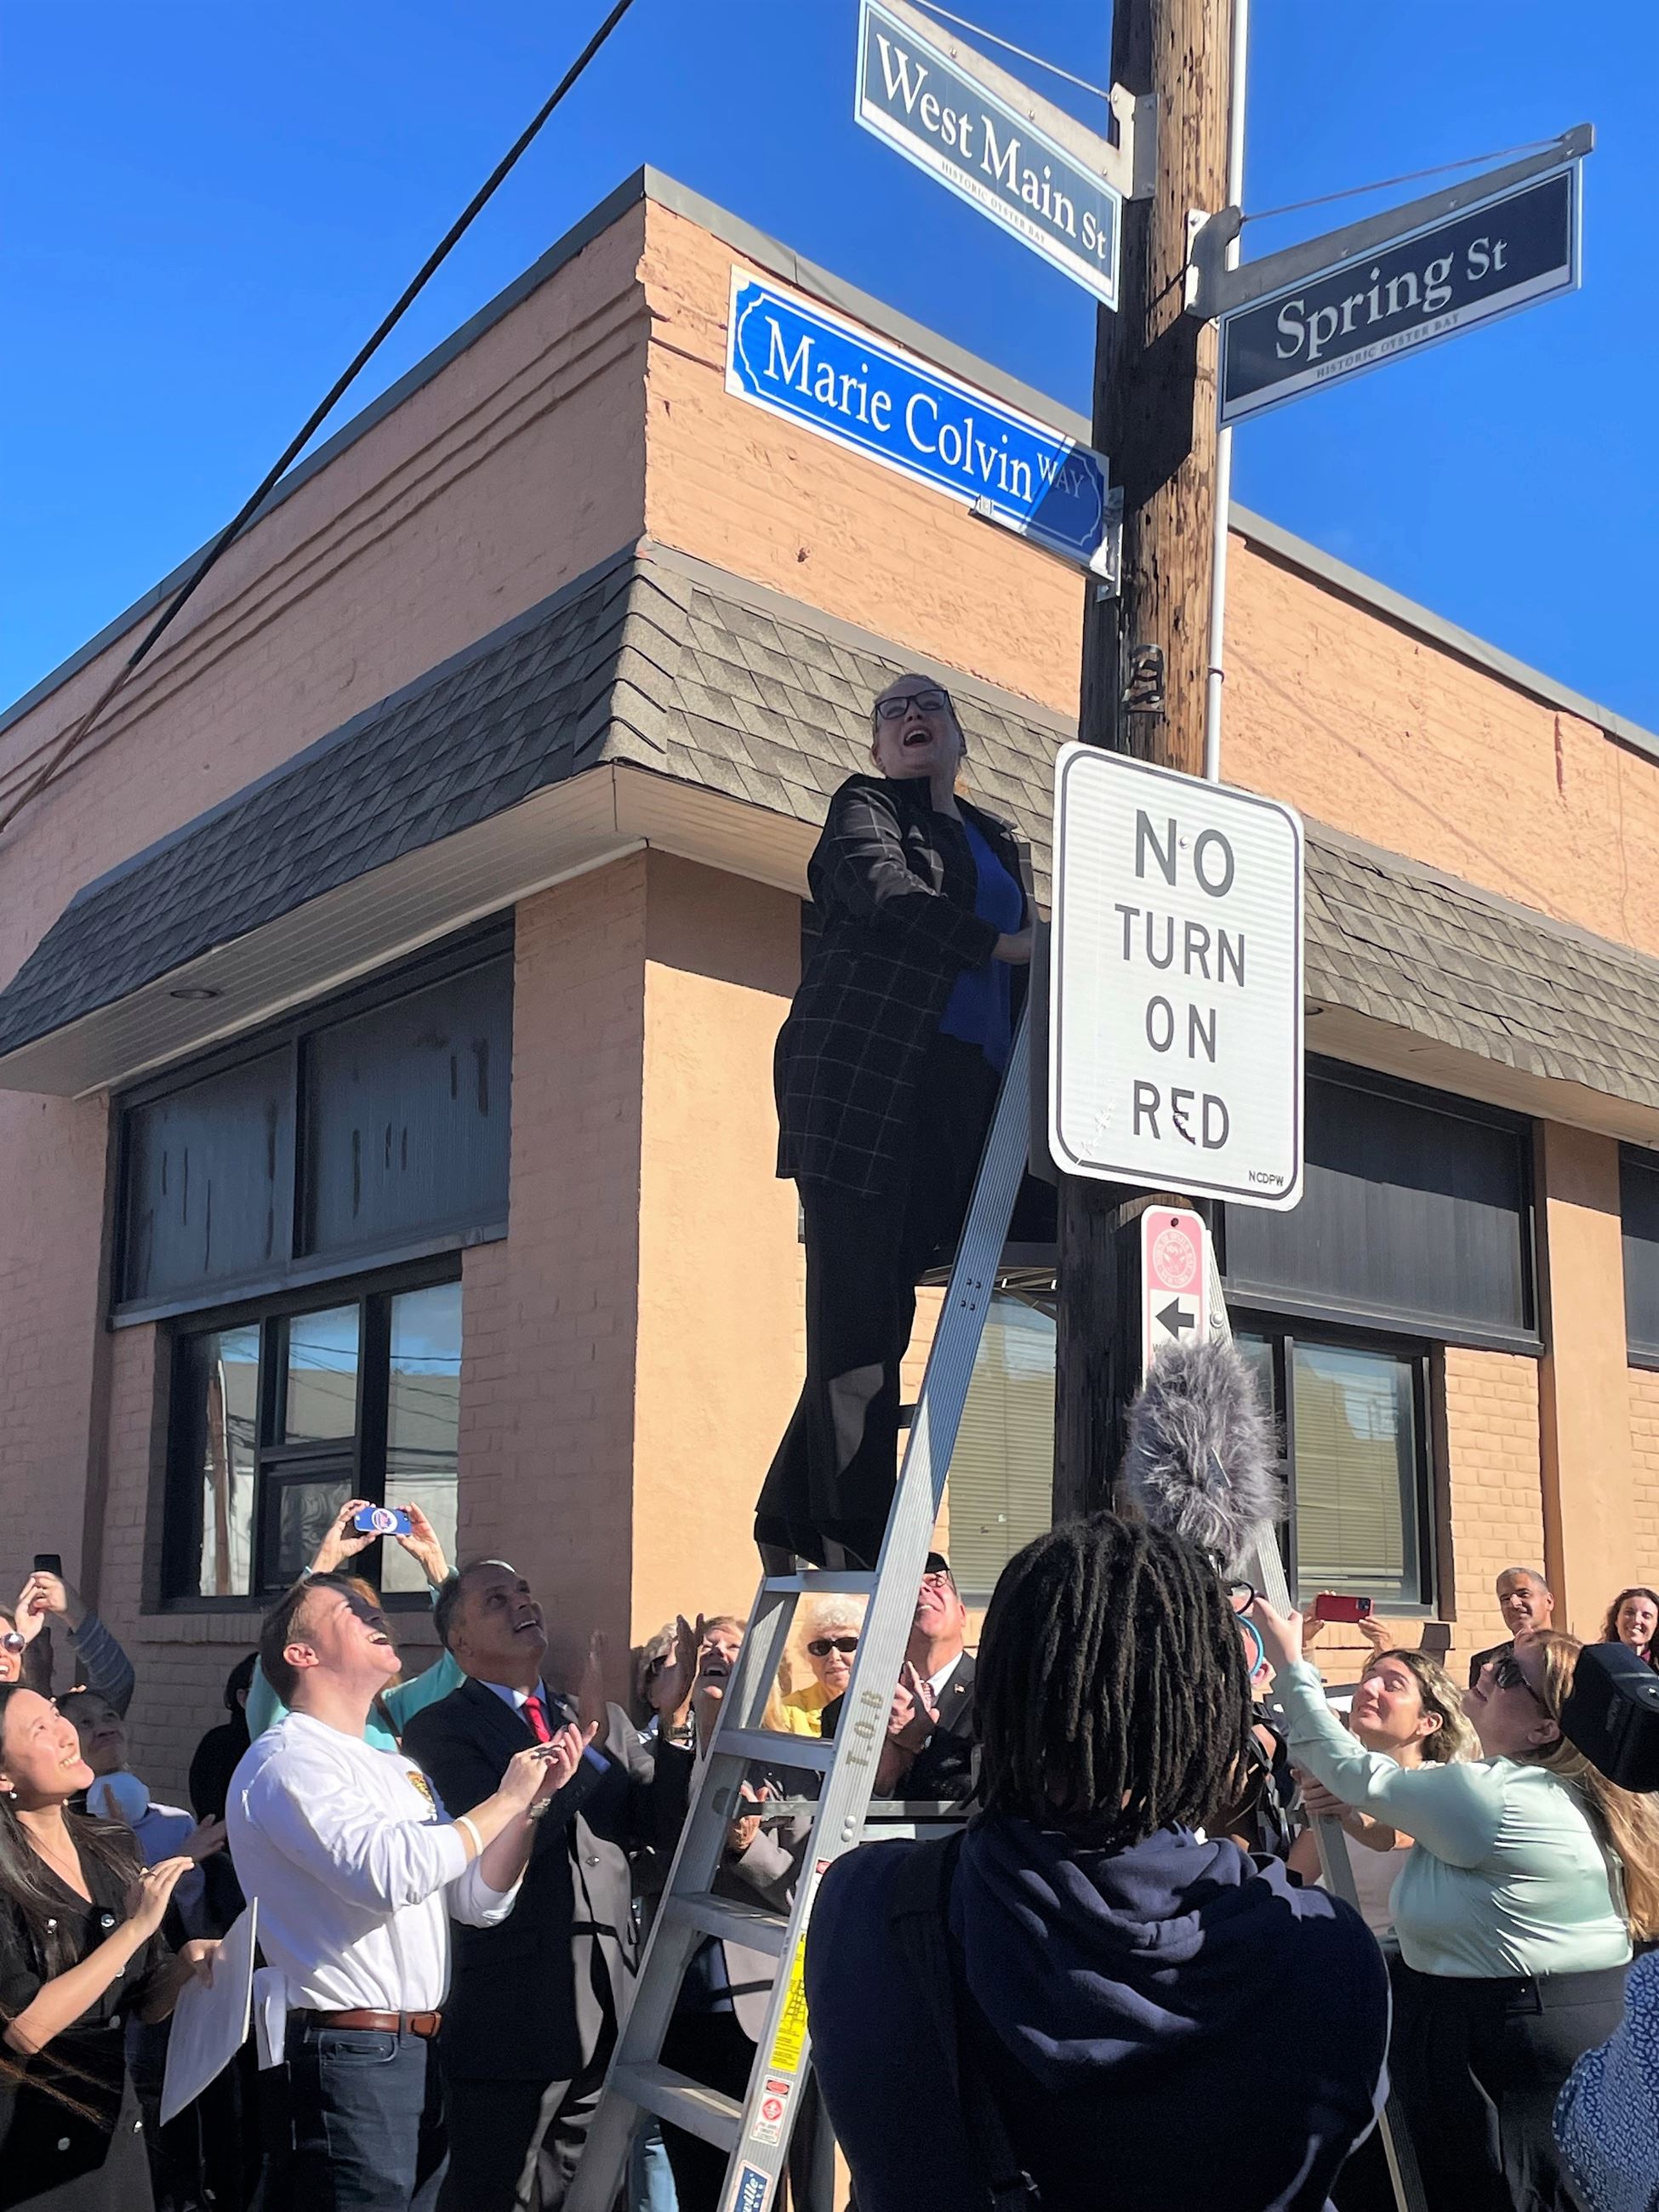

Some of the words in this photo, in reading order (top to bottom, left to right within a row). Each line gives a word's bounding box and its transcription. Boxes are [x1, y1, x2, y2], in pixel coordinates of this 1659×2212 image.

[876, 33, 973, 158] West
[980, 115, 1077, 238] Main
[1082, 211, 1107, 259] St
[941, 160, 989, 201] HISTORIC
[990, 195, 1026, 230] OYSTER
[1028, 223, 1046, 244] BAY
[1275, 252, 1454, 362] Spring
[1466, 237, 1508, 281] St
[1316, 346, 1377, 379] HISTORIC
[1380, 325, 1429, 355] OYSTER
[1434, 312, 1460, 334] BAY
[763, 315, 892, 432] Marie
[905, 392, 1033, 503] Colvin
[1037, 453, 1086, 499] WAY
[1135, 809, 1234, 898] NO
[1115, 904, 1245, 987] TURN
[1146, 995, 1216, 1063] ON
[1133, 1080, 1229, 1149] RED
[1248, 1169, 1285, 1188] NCDPW
